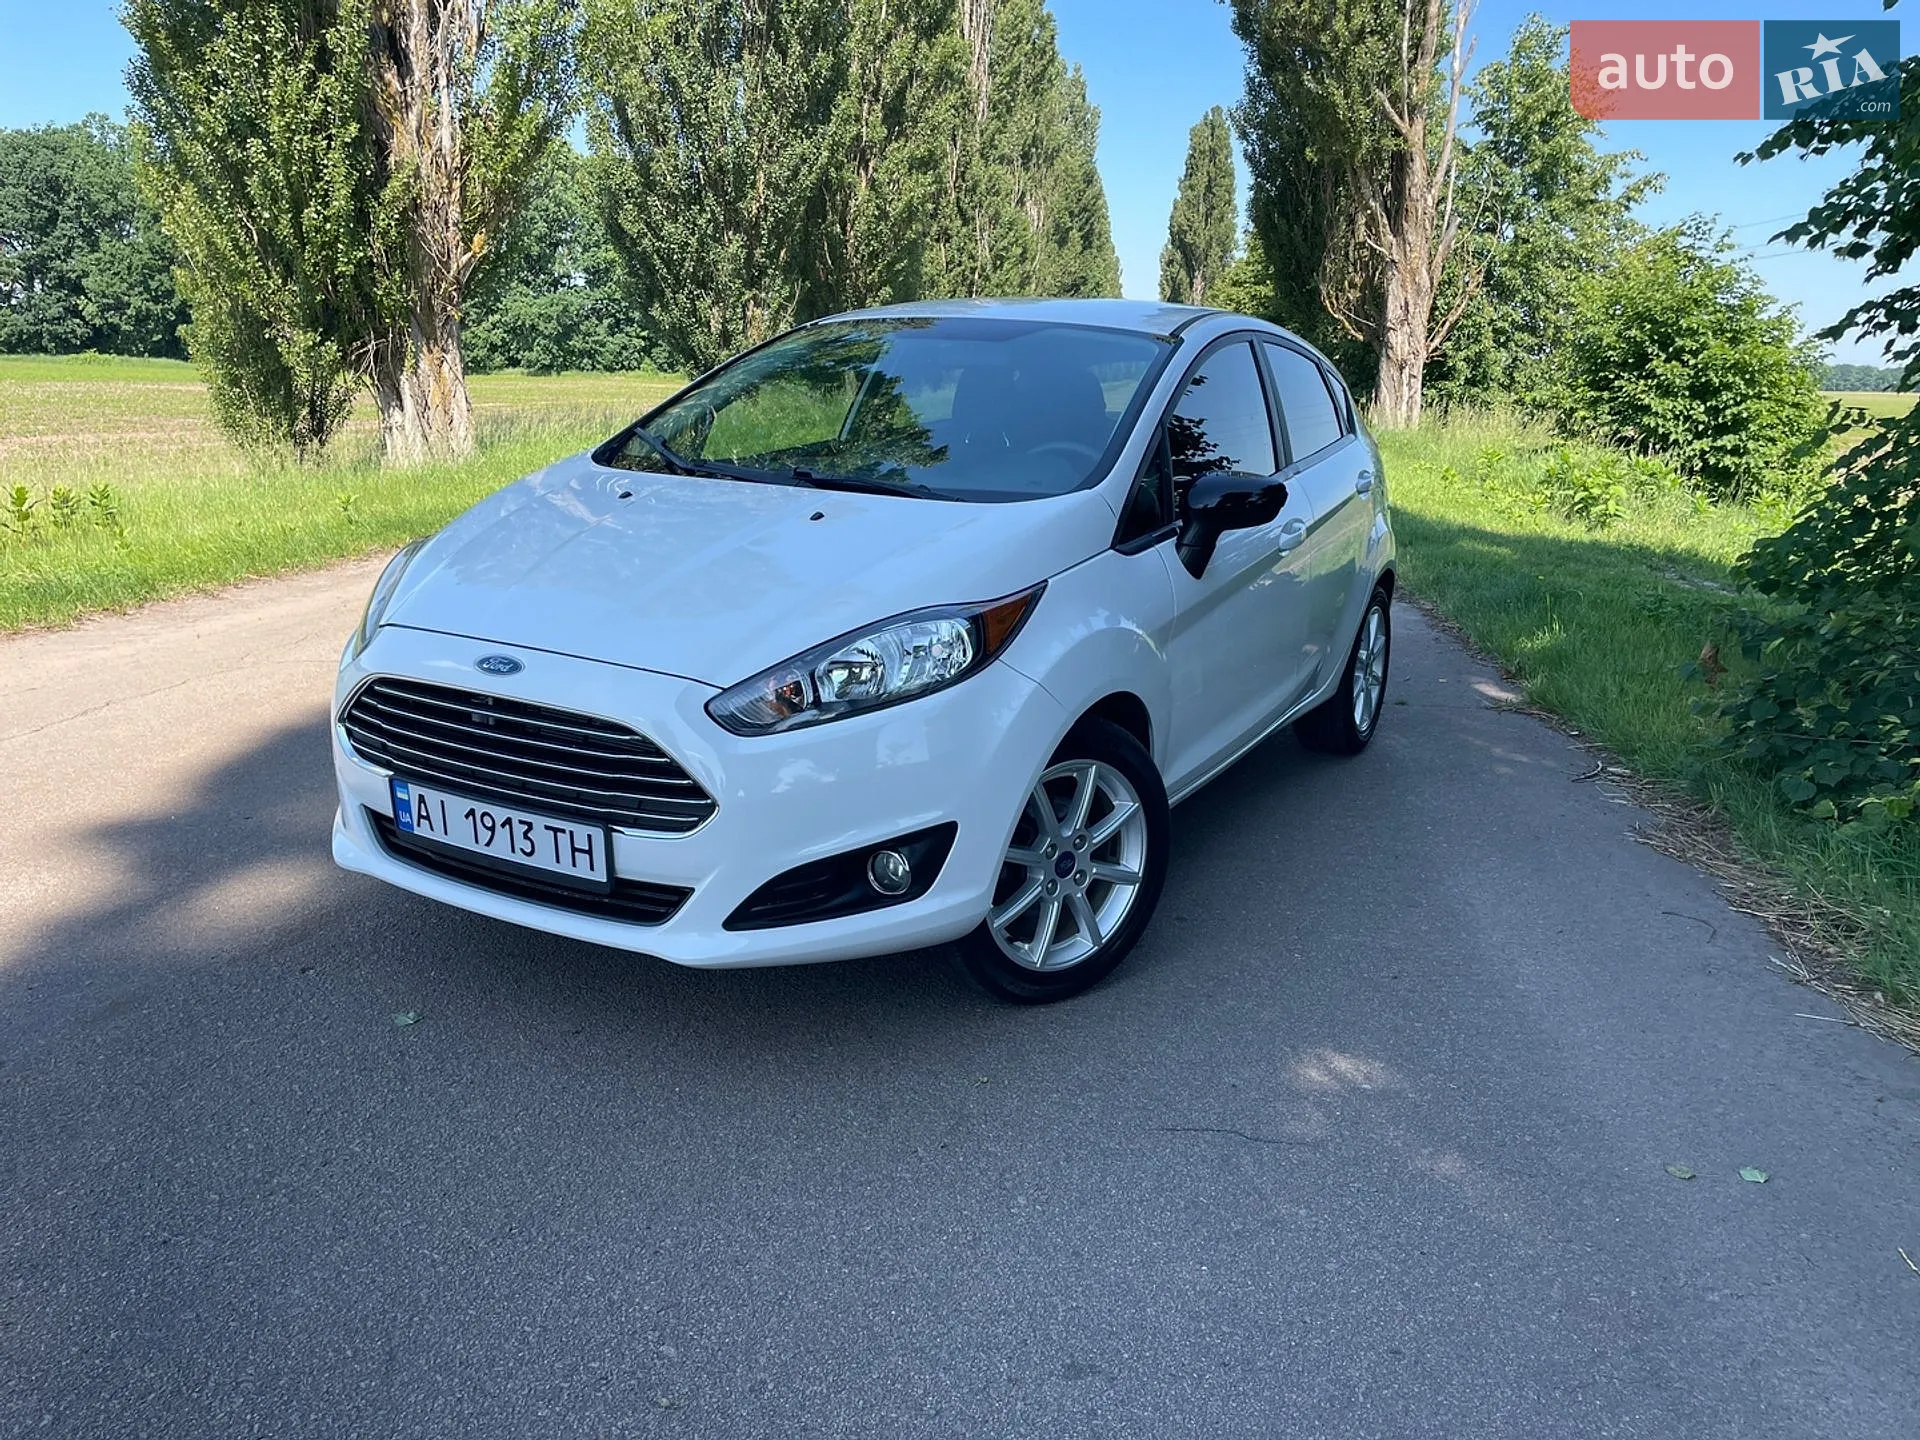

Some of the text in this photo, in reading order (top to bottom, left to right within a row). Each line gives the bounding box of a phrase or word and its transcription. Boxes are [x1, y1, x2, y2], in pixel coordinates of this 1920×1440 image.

[399, 810, 412, 825] UA
[416, 793, 595, 872] AI 1913 TH
